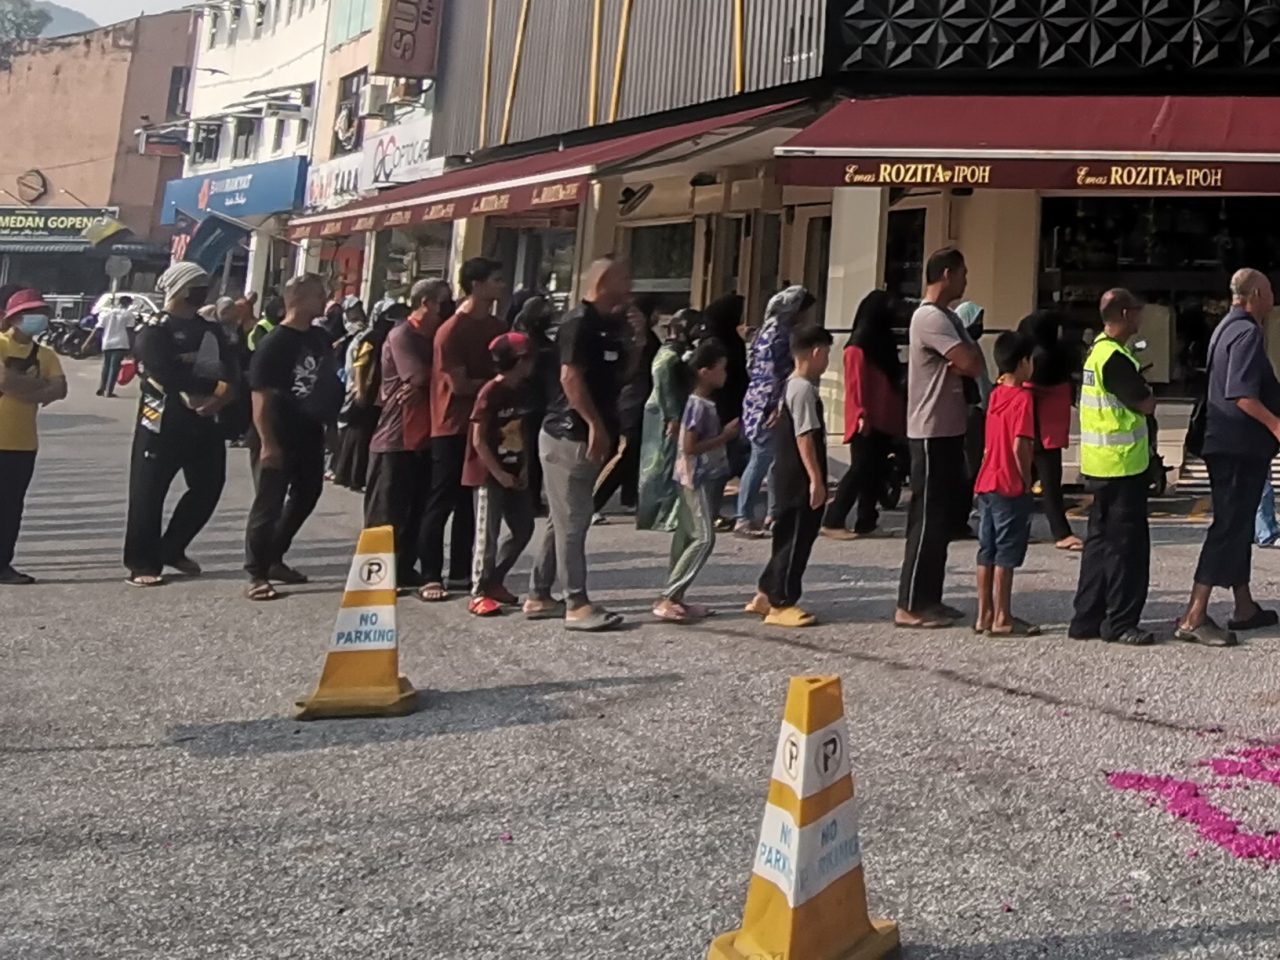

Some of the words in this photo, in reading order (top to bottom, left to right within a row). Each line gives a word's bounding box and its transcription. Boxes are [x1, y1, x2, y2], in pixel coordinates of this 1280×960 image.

[845, 165, 876, 183] Emas
[878, 164, 945, 183] ROZITA
[953, 165, 991, 183] IPOH
[1076, 166, 1108, 185] Emas
[1110, 166, 1178, 186] ROZITA
[1186, 168, 1222, 186] IPOH
[0, 216, 45, 228] MEDAN
[359, 612, 378, 626] NO
[336, 629, 395, 645] PARKING
[822, 819, 838, 847] NO
